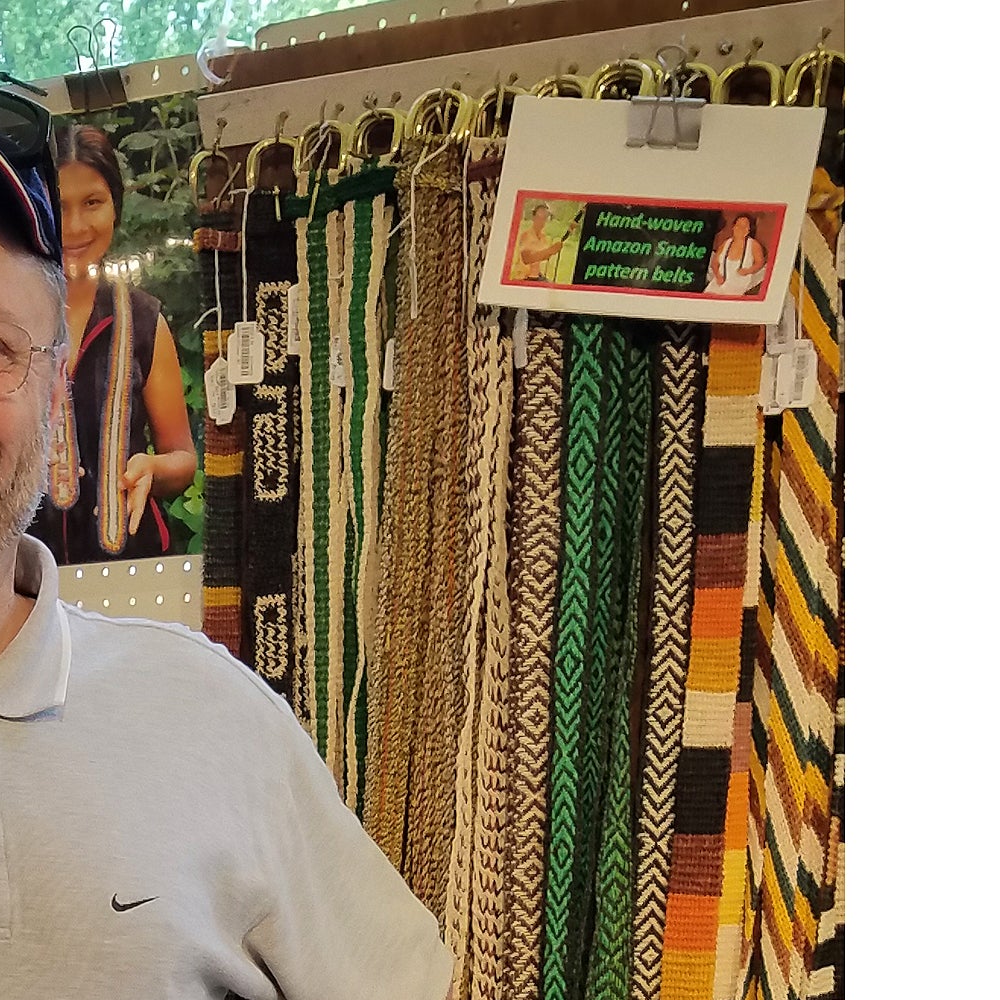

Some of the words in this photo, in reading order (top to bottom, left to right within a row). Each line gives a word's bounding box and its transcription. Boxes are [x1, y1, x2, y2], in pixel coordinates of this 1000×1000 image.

[596, 211, 704, 233] Hand-woven
[583, 236, 652, 255] Amazon
[655, 240, 707, 259] Snake
[584, 263, 648, 280] pattern
[652, 265, 695, 284] belts
